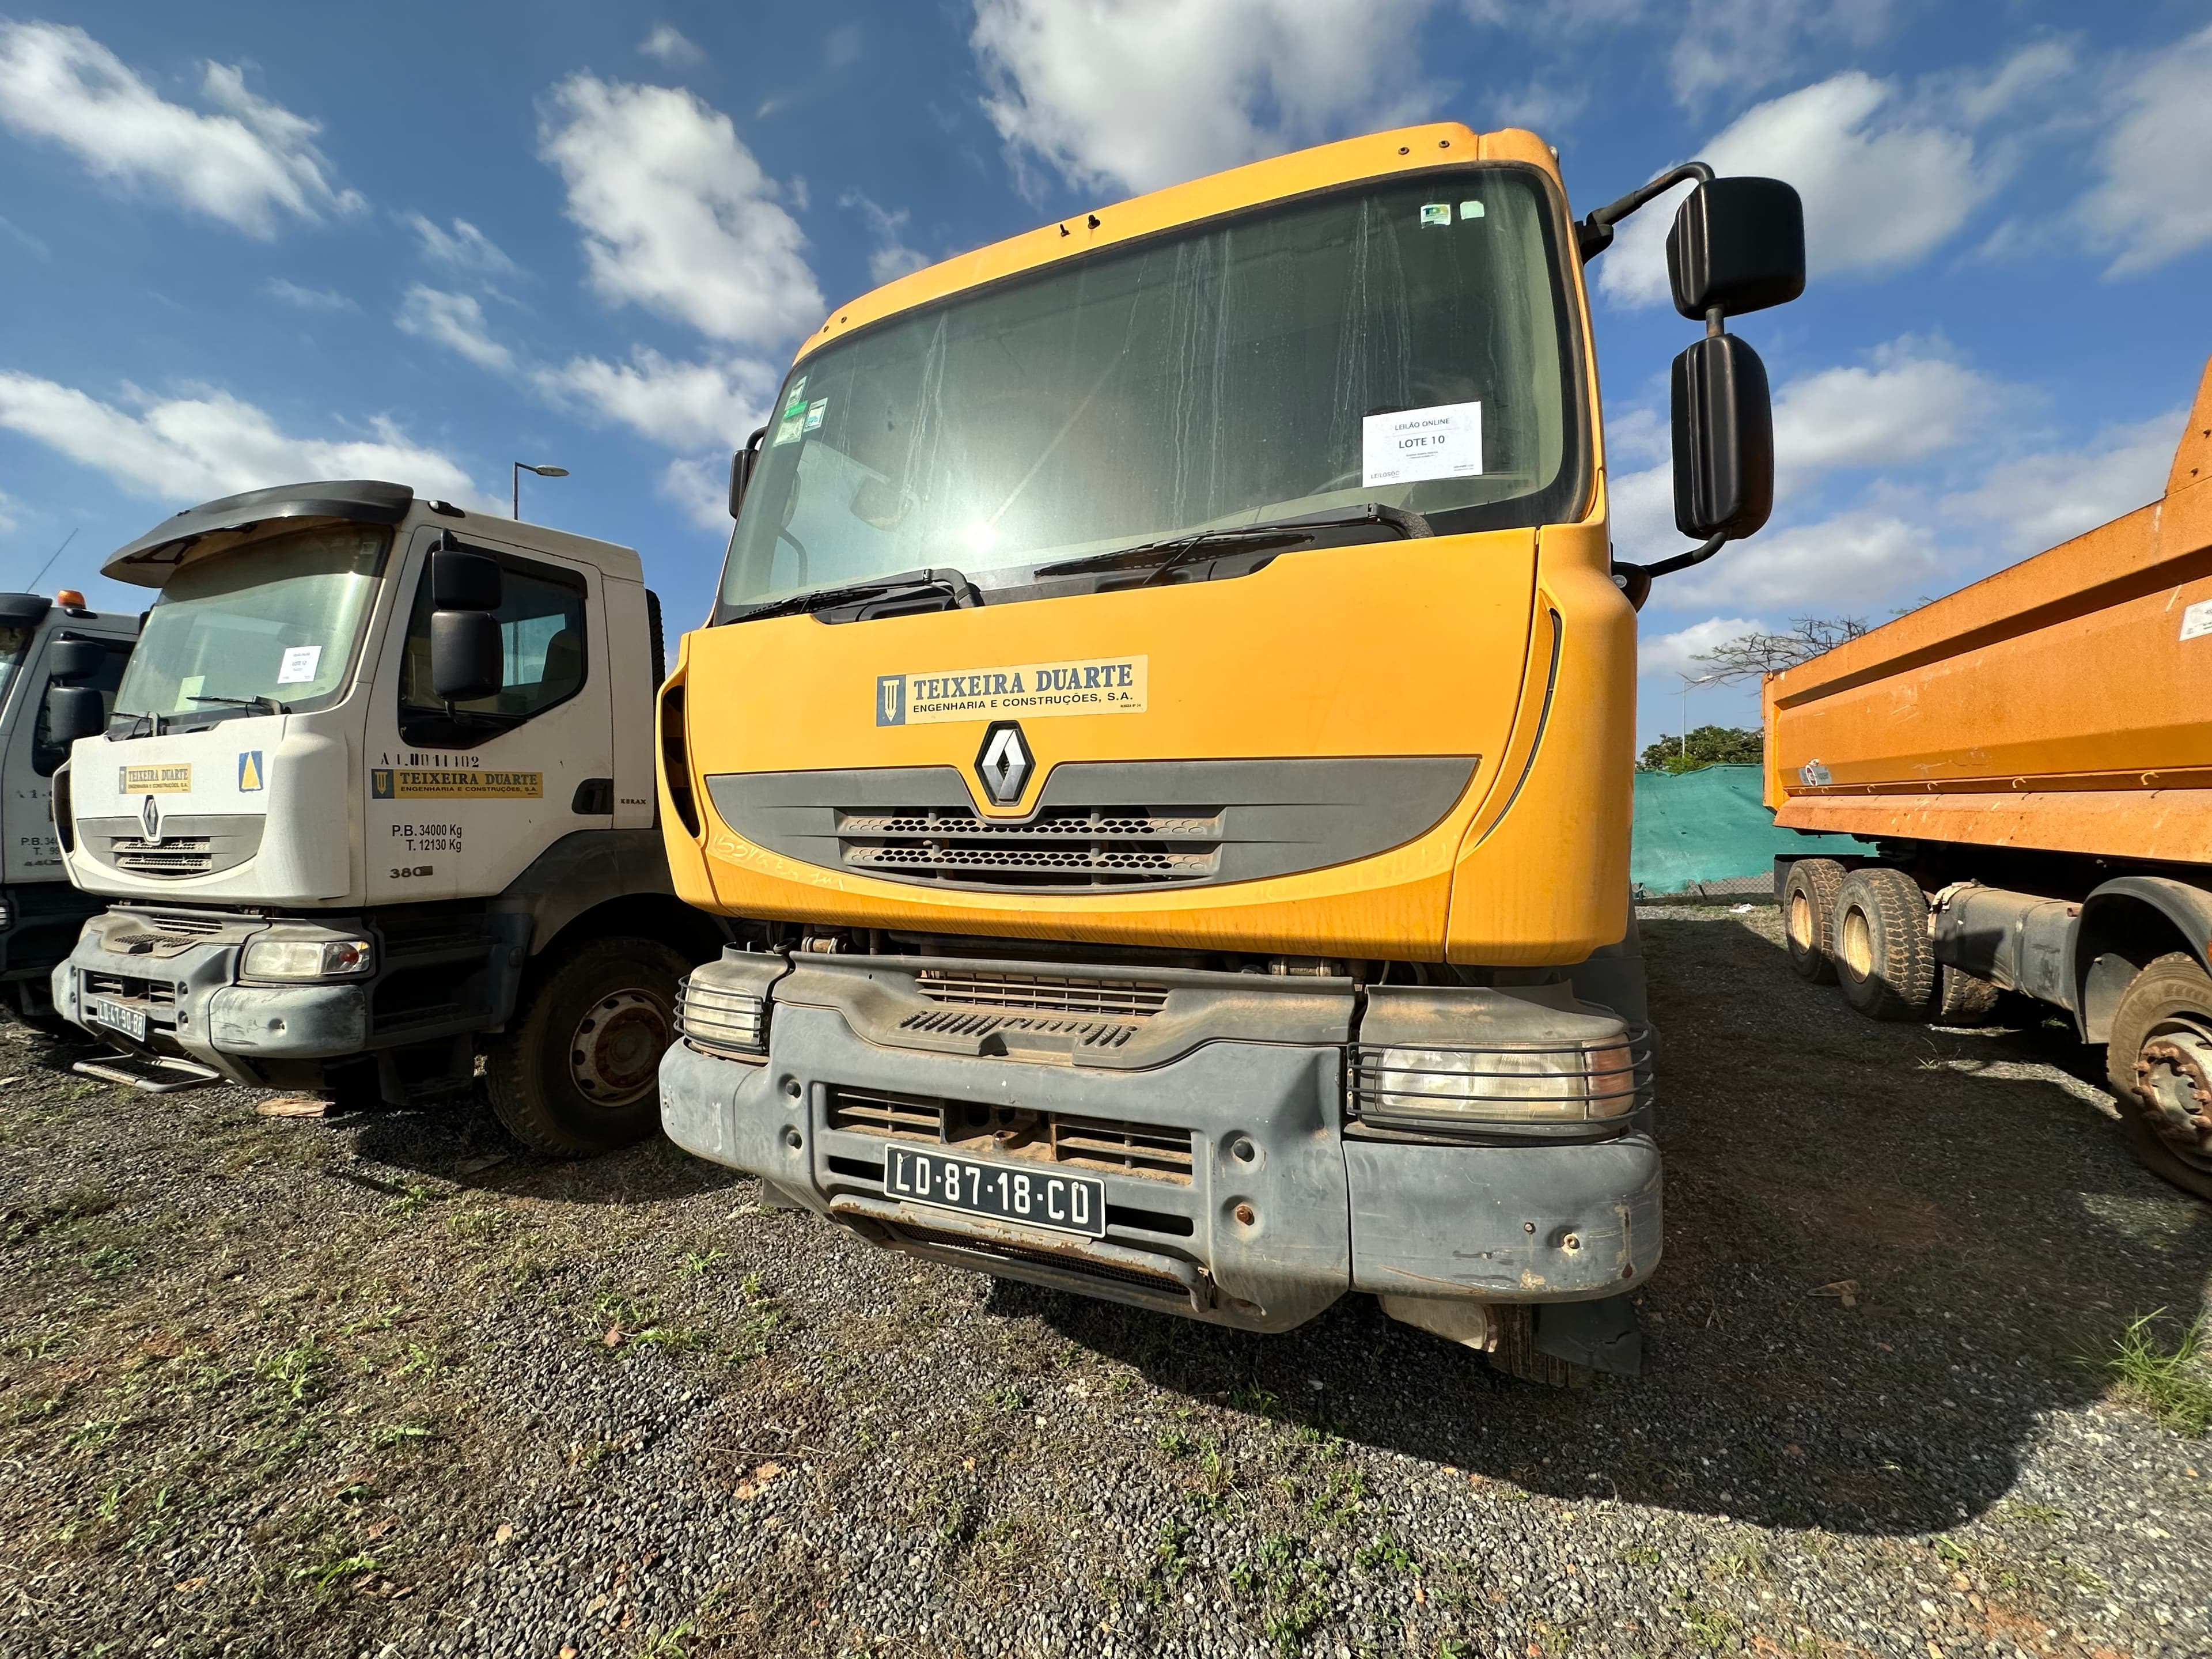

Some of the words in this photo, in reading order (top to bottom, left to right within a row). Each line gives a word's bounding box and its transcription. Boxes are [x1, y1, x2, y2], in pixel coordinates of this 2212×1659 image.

[1395, 421, 1420, 431] LEILÃO
[1422, 418, 1450, 427] ONLINE
[1399, 437, 1427, 449] LOTE
[1431, 435, 1445, 445] 10
[914, 672, 1025, 700] TEIXEIRA
[1036, 664, 1133, 692] DUARTE
[913, 700, 986, 713] ENGENHARIA
[991, 699, 998, 707] E
[1003, 693, 1101, 707] CONSTRUÇÕES,
[1107, 691, 1133, 701] S.A.
[128, 770, 159, 782] TEIXEIRA
[161, 768, 188, 781] DUARTE
[400, 772, 479, 785] TEIXEIRA
[484, 774, 538, 785] DUARTE
[392, 824, 417, 836] P.B.
[419, 824, 447, 836] 34000
[449, 824, 462, 838] Kg
[21, 838, 43, 846] P.B.
[406, 839, 416, 851] T.
[419, 839, 446, 851] 12130
[449, 838, 461, 853] Kg
[33, 847, 43, 855] T.
[896, 1153, 1089, 1225] LD-87-18-CD
